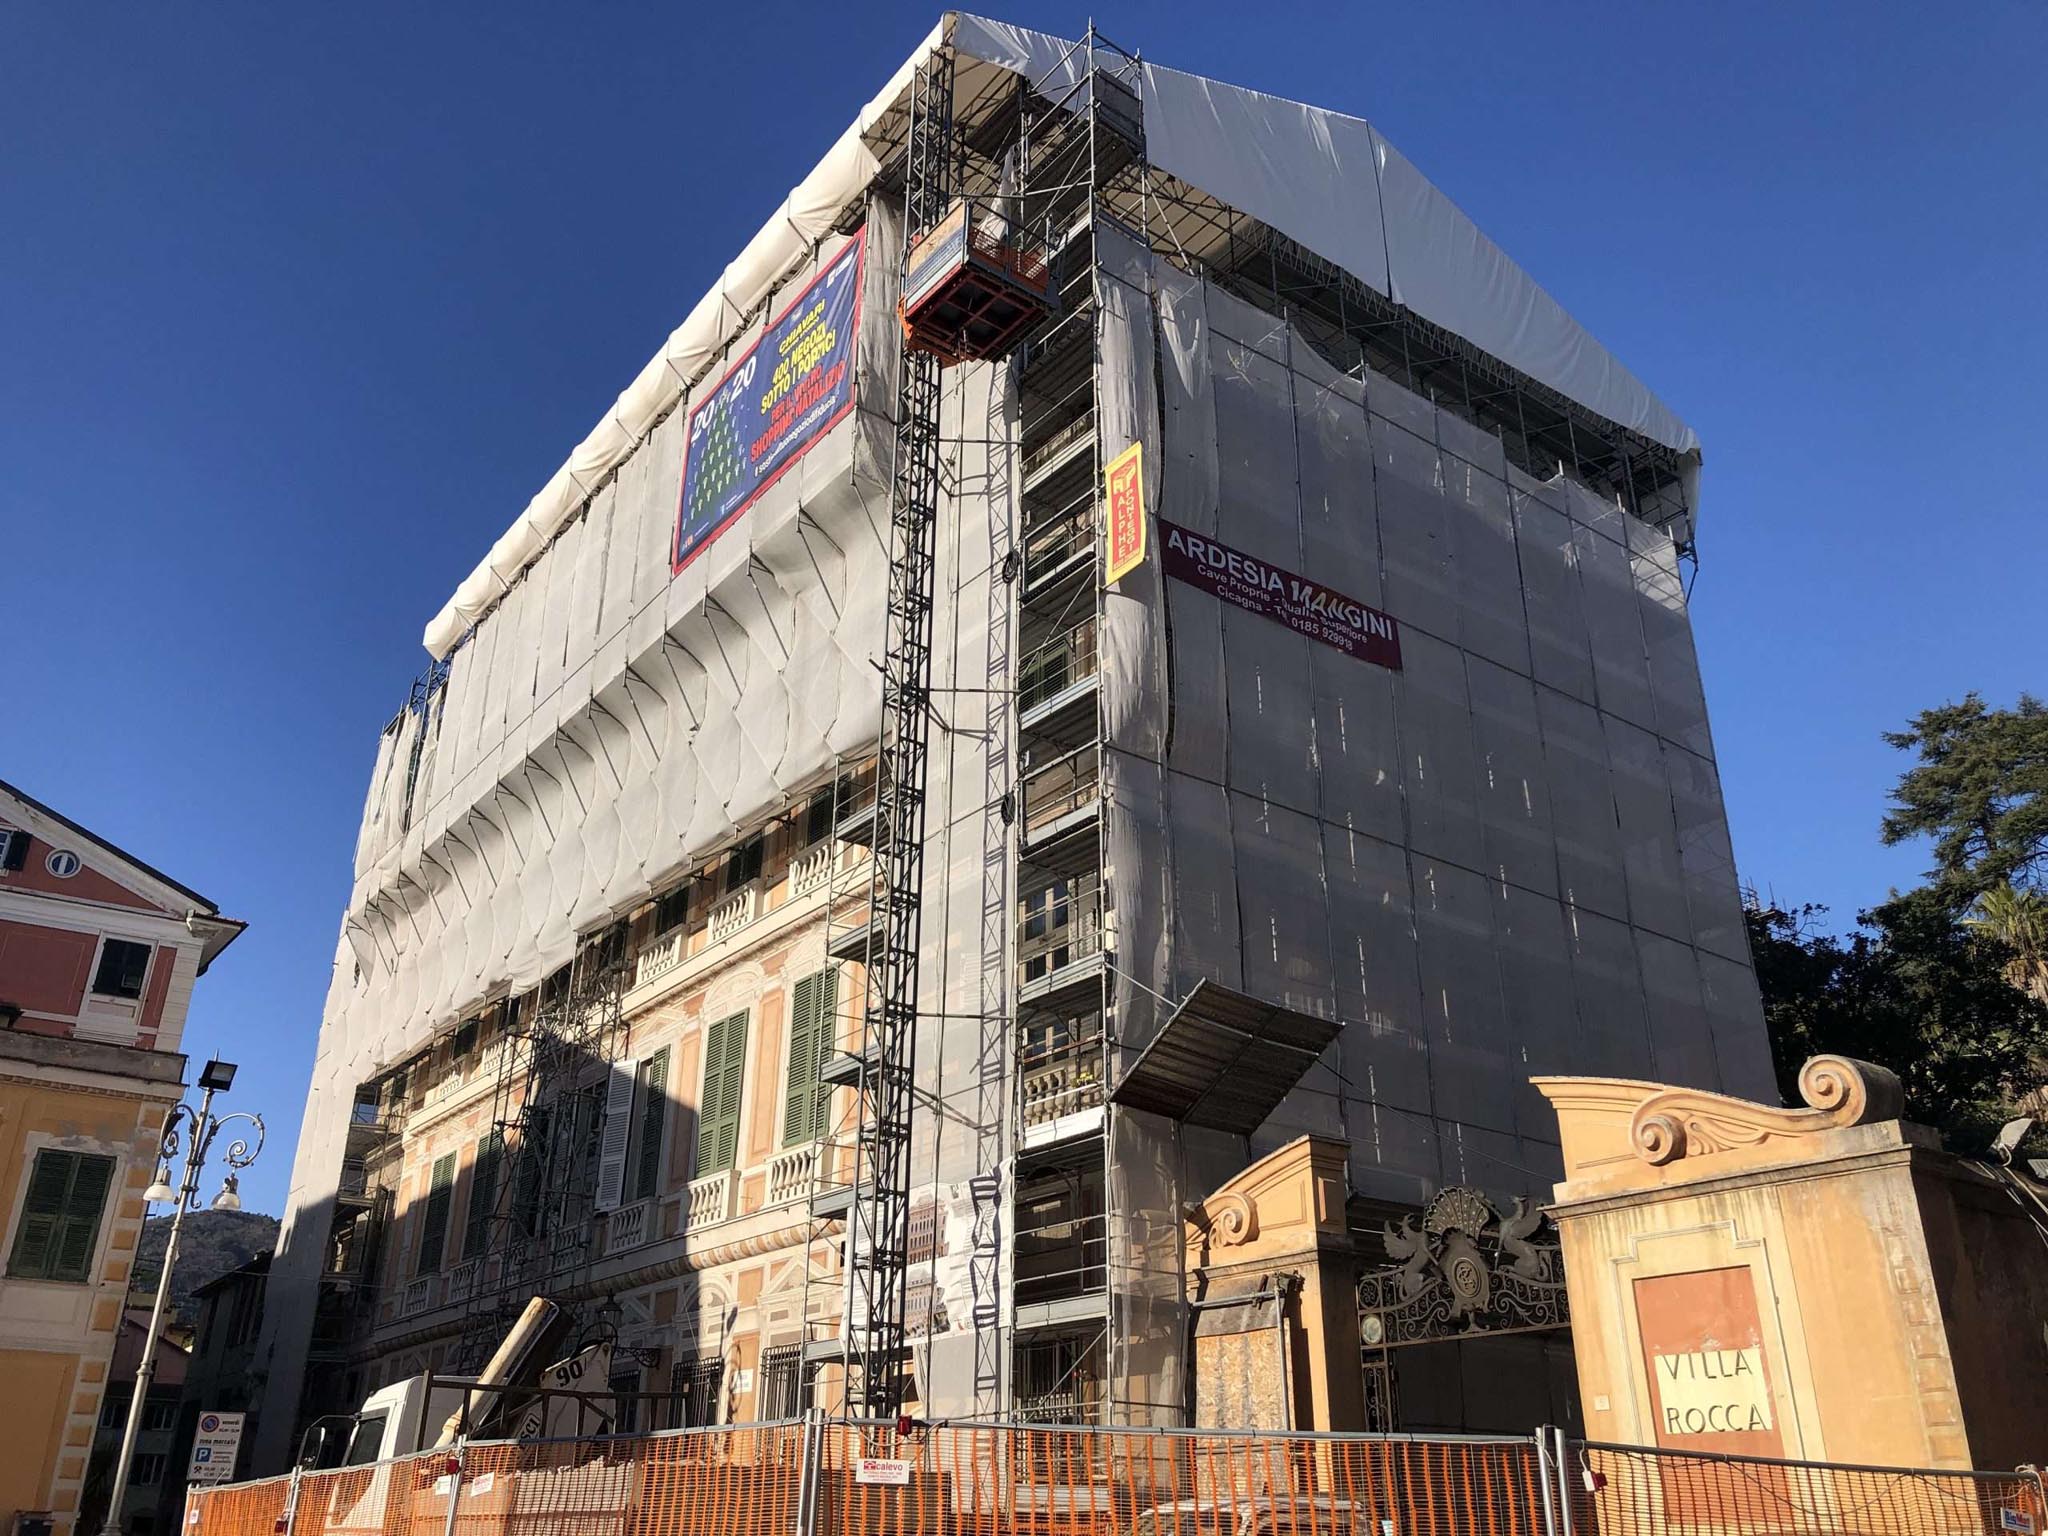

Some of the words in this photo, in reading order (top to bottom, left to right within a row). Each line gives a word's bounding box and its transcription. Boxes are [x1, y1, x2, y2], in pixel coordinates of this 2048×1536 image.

[772, 357, 790, 384] 400
[791, 320, 827, 368] NEGOZI
[779, 299, 825, 353] CHIAVARI
[691, 399, 715, 443] 20
[731, 355, 757, 402] 20
[761, 373, 791, 415] SOTTO
[796, 328, 836, 379] PORTICI
[795, 359, 846, 417] NATALIZIO
[1117, 495, 1126, 558] ALPHE
[1125, 488, 1136, 551] PONTEGGI
[1168, 529, 1285, 596] ARDESIA
[1290, 580, 1393, 641] MANGINI
[1197, 564, 1228, 584] Cave
[1229, 576, 1271, 602] Proprie
[1216, 585, 1263, 611] Cicagna
[1291, 617, 1320, 635] 0185
[556, 1360, 583, 1387] 90
[1663, 1349, 1753, 1381] VILLA
[1666, 1403, 1768, 1434] ROCCA
[876, 1462, 903, 1471] calevo
